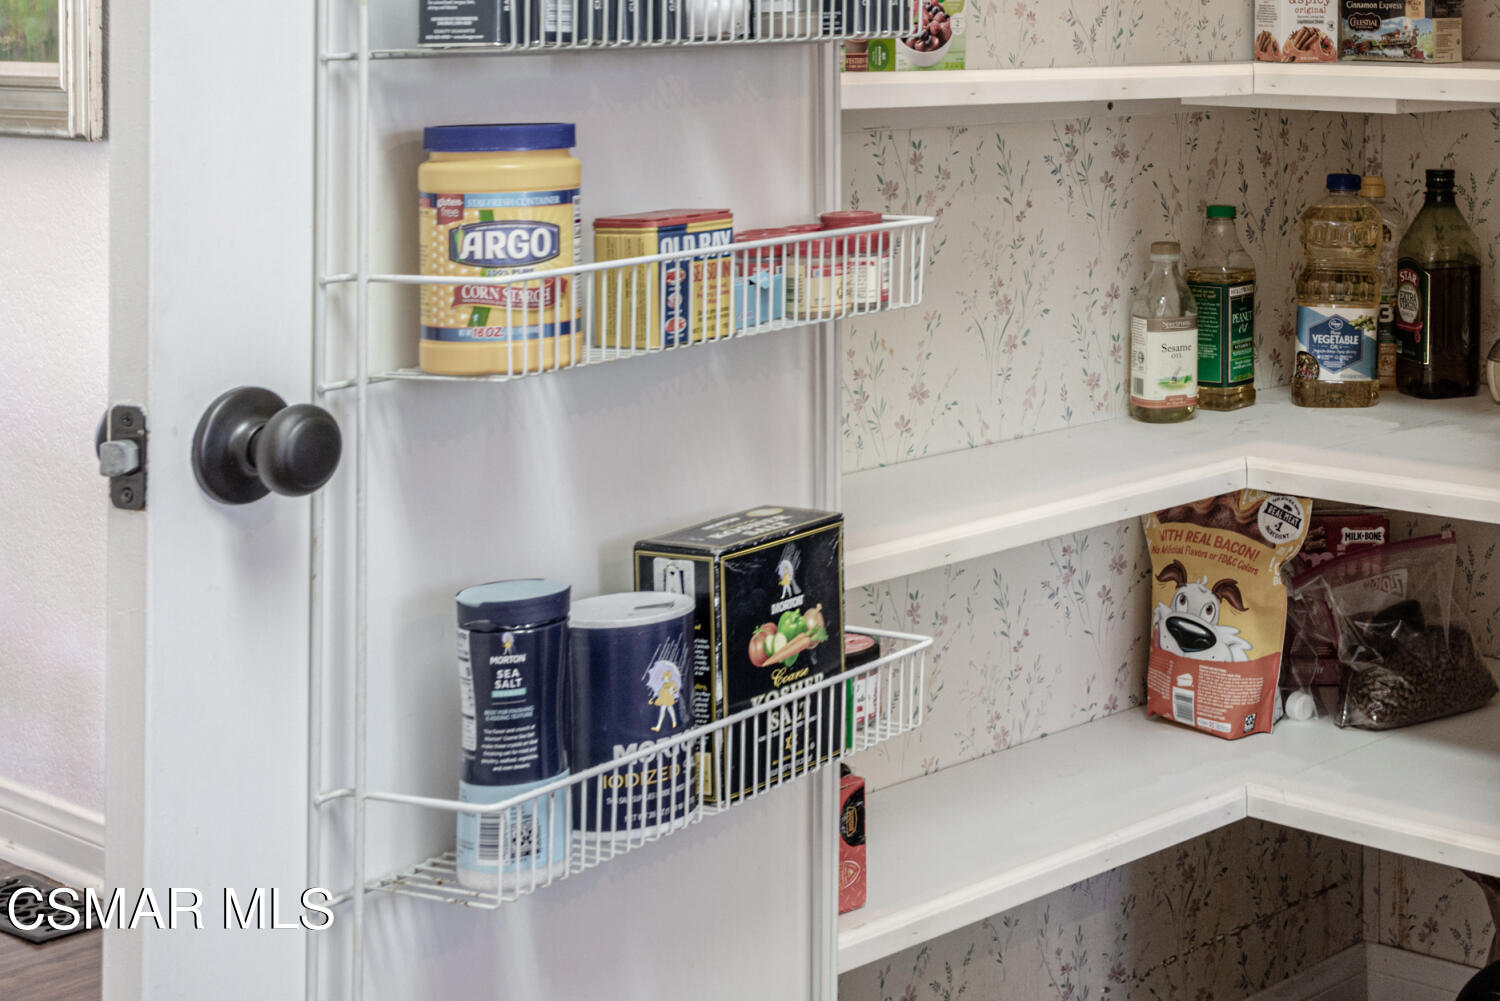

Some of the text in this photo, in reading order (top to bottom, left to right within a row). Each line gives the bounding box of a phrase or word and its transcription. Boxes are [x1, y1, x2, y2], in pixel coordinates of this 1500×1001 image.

[1294, 6, 1327, 15] original
[1346, 1, 1403, 10] Cinnamon Express
[440, 207, 460, 218] free
[459, 227, 553, 261] ARGO
[1400, 270, 1417, 285] STAR
[461, 284, 500, 300] CORN
[1312, 334, 1360, 345] VEGETABLE
[1161, 343, 1193, 353] Sesame
[1185, 530, 1212, 546] REAL
[1213, 535, 1260, 562] BACON!
[1185, 545, 1208, 559] Flavors
[489, 654, 527, 665] MORTON
[496, 668, 521, 679] SEA
[494, 679, 523, 690] SALT
[602, 764, 681, 790] IODIZED
